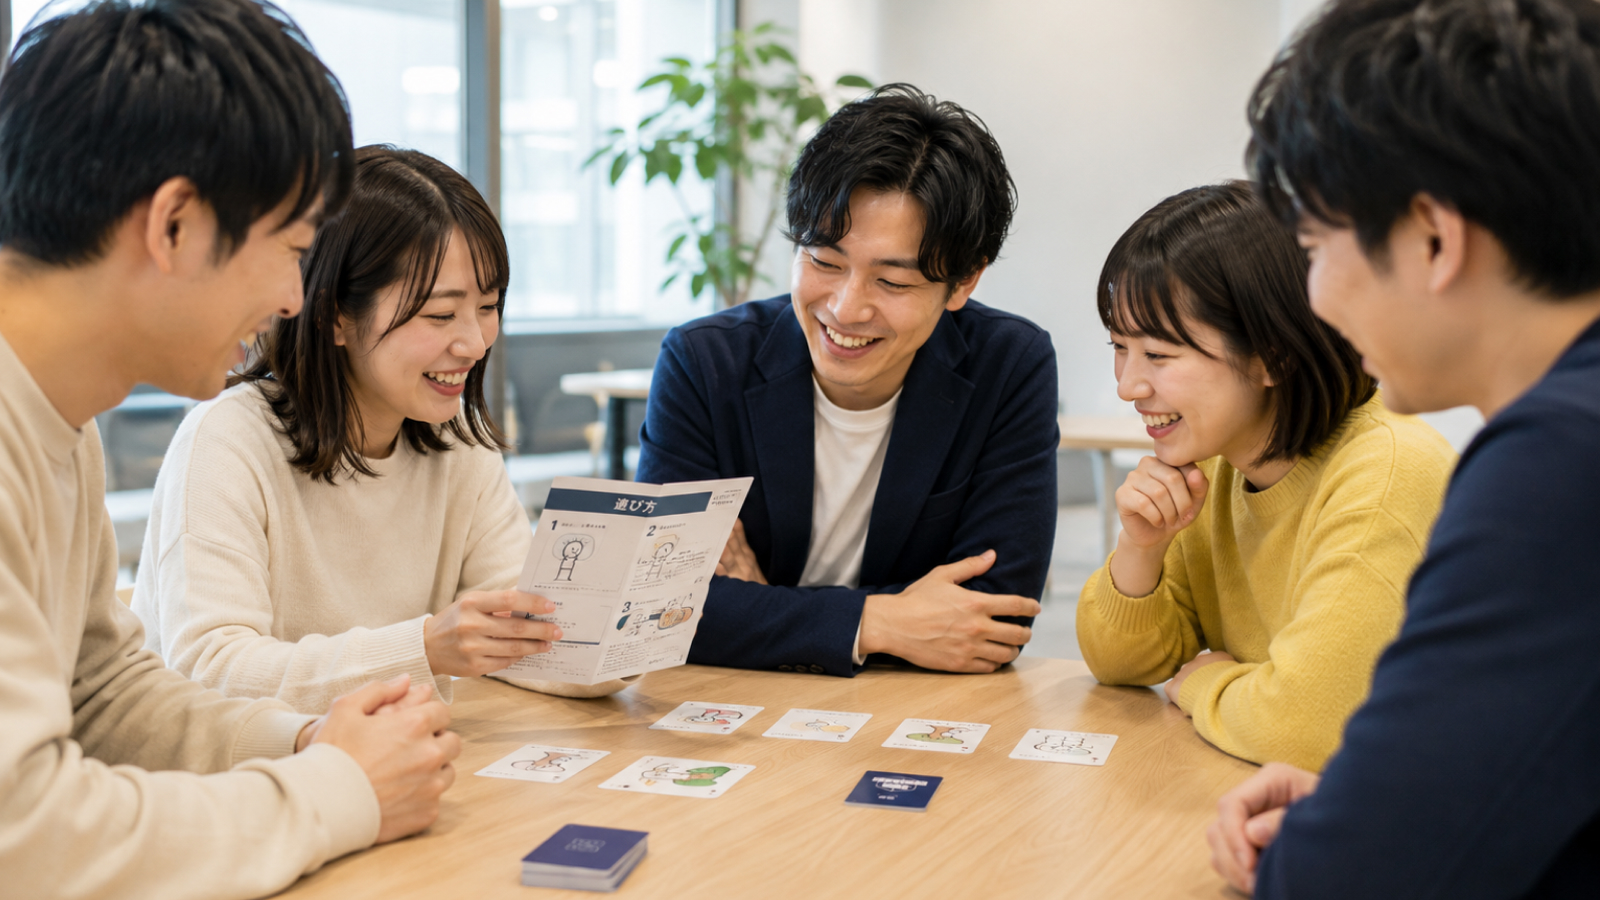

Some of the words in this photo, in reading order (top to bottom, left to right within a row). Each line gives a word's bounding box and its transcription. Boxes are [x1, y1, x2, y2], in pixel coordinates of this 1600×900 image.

[551, 520, 558, 531] 1
[646, 525, 657, 537] 2
[622, 601, 632, 613] 3
